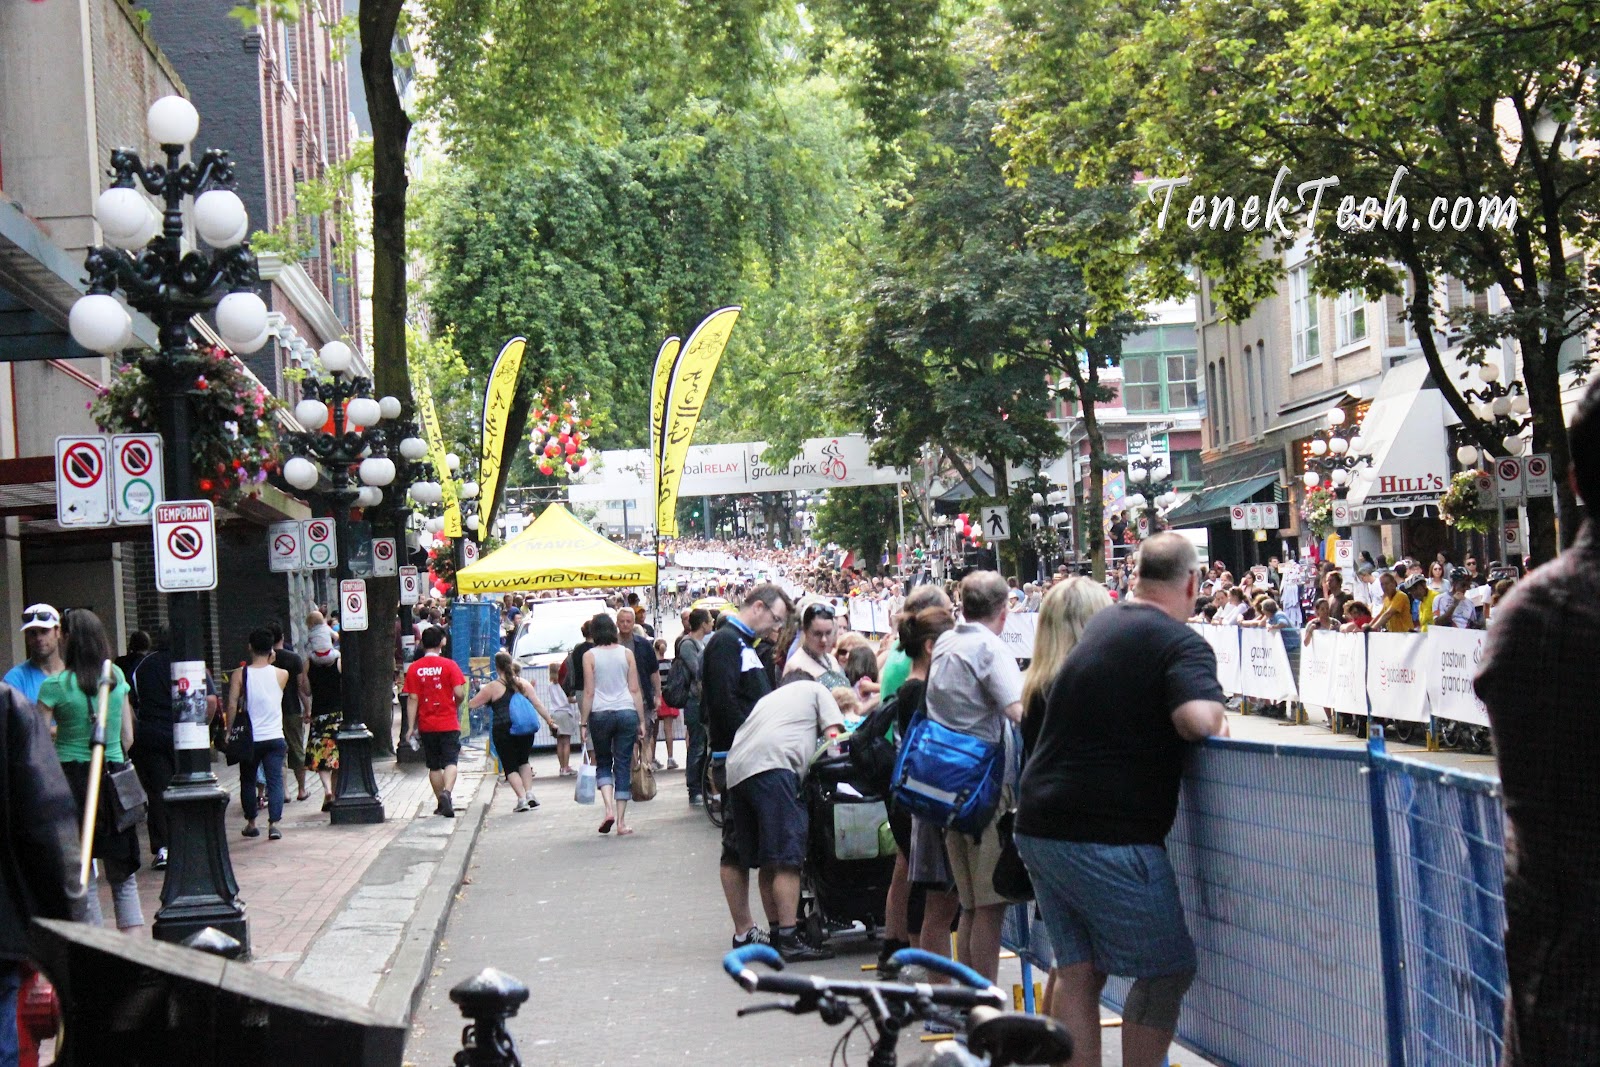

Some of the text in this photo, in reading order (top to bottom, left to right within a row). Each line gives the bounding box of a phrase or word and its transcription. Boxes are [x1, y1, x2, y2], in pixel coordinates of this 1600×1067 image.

[793, 461, 817, 477] prix
[1378, 472, 1444, 494] HILL'S
[158, 506, 210, 522] TEMPORARY
[472, 571, 641, 590] www.mavic.com
[1441, 649, 1467, 672] gastown
[416, 666, 443, 677] CREW
[1441, 674, 1461, 696] grand
